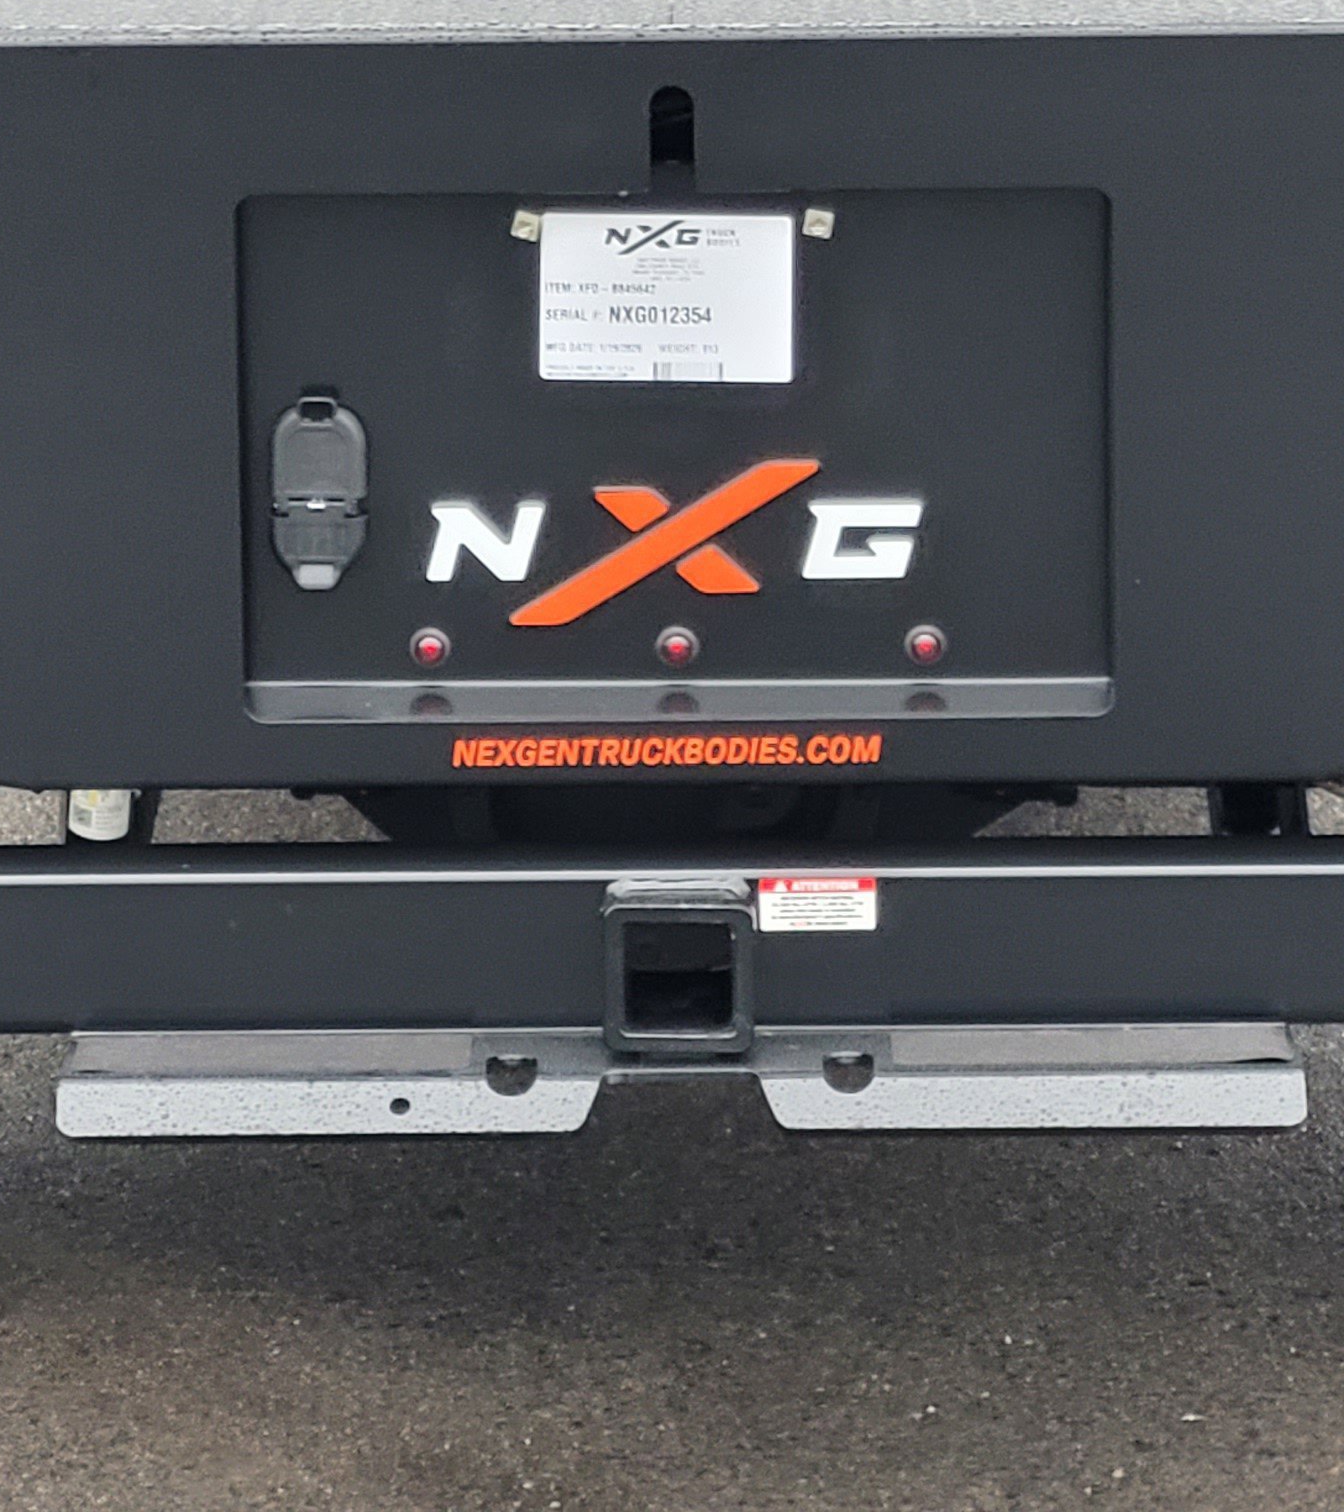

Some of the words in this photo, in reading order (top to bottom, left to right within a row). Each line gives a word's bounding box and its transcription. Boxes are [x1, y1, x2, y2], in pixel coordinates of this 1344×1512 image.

[604, 219, 702, 256] NXG
[545, 308, 588, 322] SERIAL
[609, 305, 712, 325] NXG012354
[425, 458, 924, 626] NXG
[452, 735, 883, 769] NEXGENTRUCKBODIES.COM
